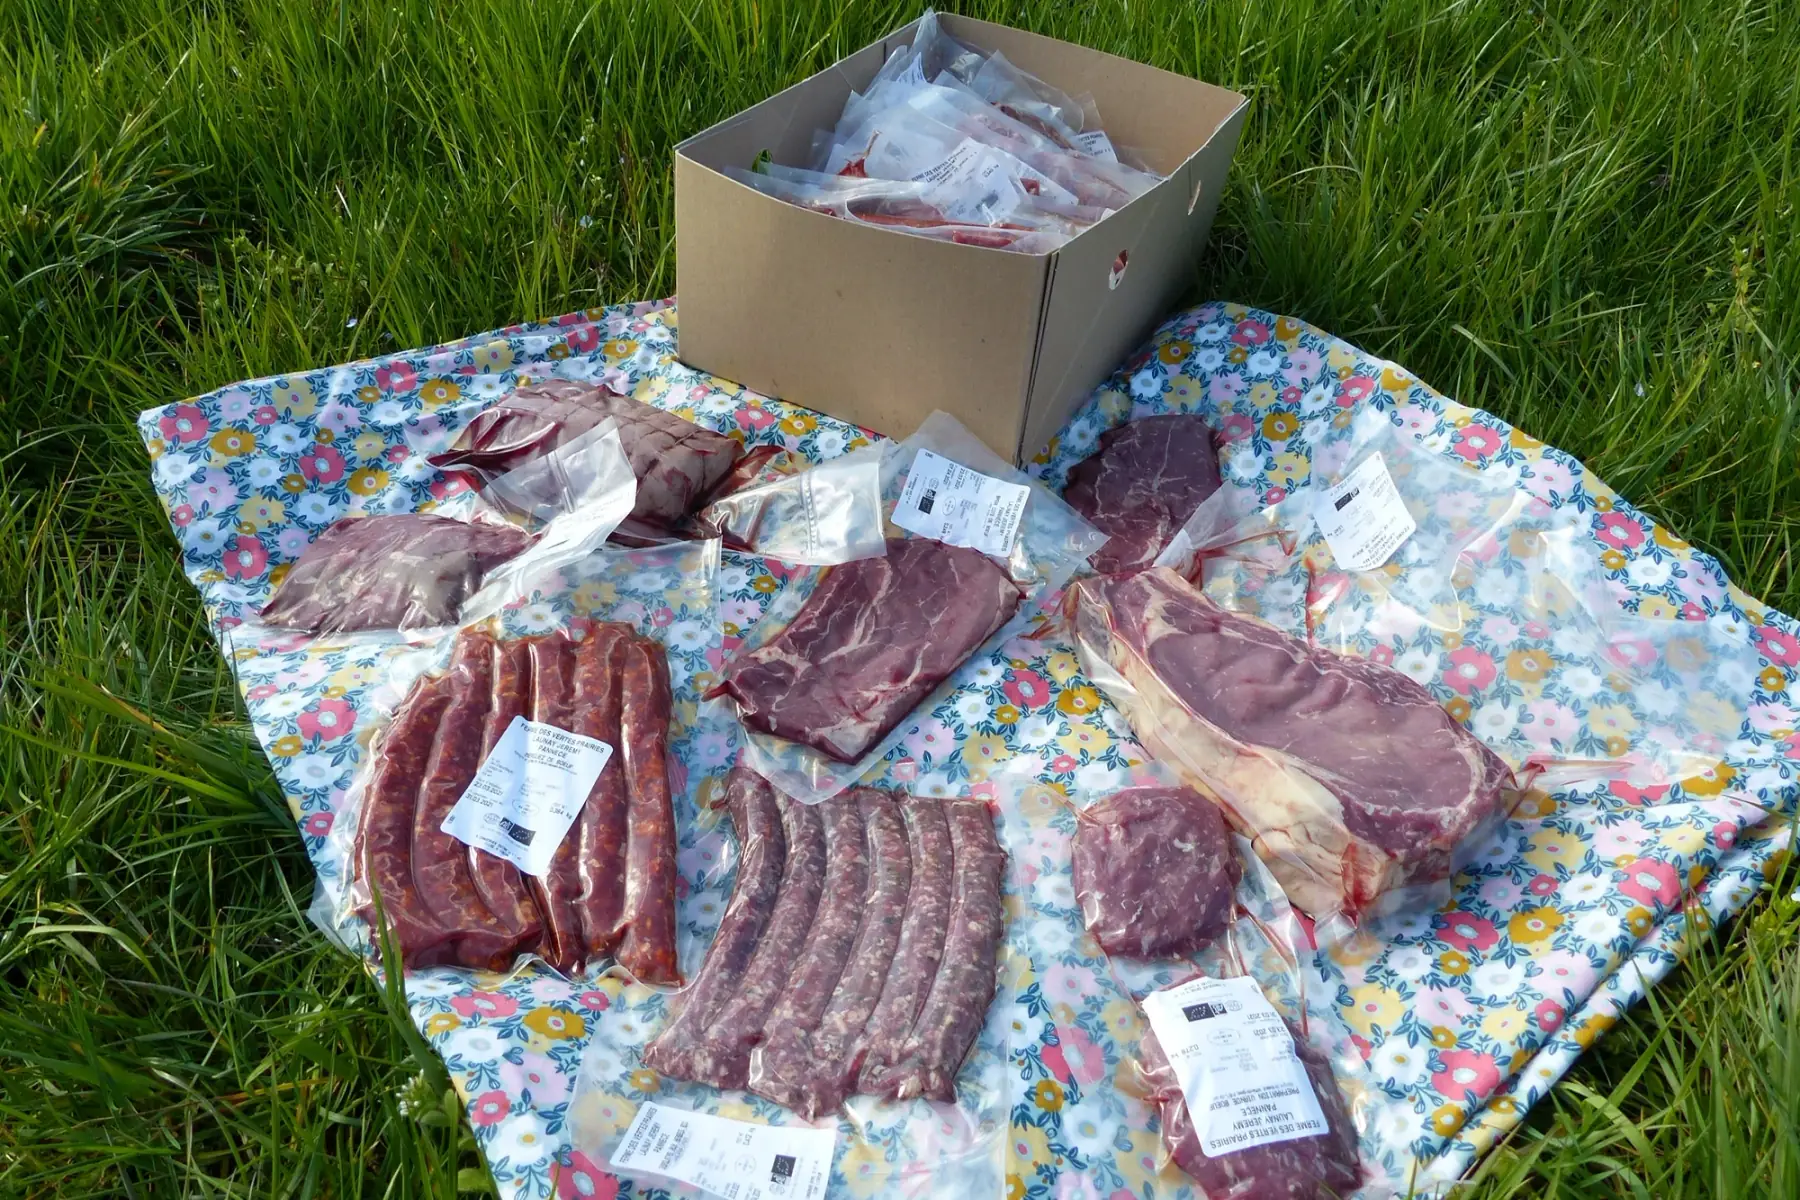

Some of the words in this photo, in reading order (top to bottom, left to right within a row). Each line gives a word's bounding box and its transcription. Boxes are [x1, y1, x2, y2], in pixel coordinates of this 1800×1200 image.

[538, 727, 551, 736] DES
[551, 731, 576, 745] VERTES
[1231, 1094, 1255, 1105] VIANDE
[1257, 1086, 1300, 1101] PREPARATION
[1208, 1099, 1229, 1111] BOEUF
[1239, 1101, 1276, 1116] PANNECE
[1231, 1116, 1262, 1130] JEREMY
[1264, 1111, 1294, 1124] LAUNAY
[1295, 1118, 1320, 1131] FERME
[1248, 1125, 1278, 1139] VERTES
[1278, 1122, 1295, 1134] DES
[1208, 1132, 1247, 1150] PRAIRIES
